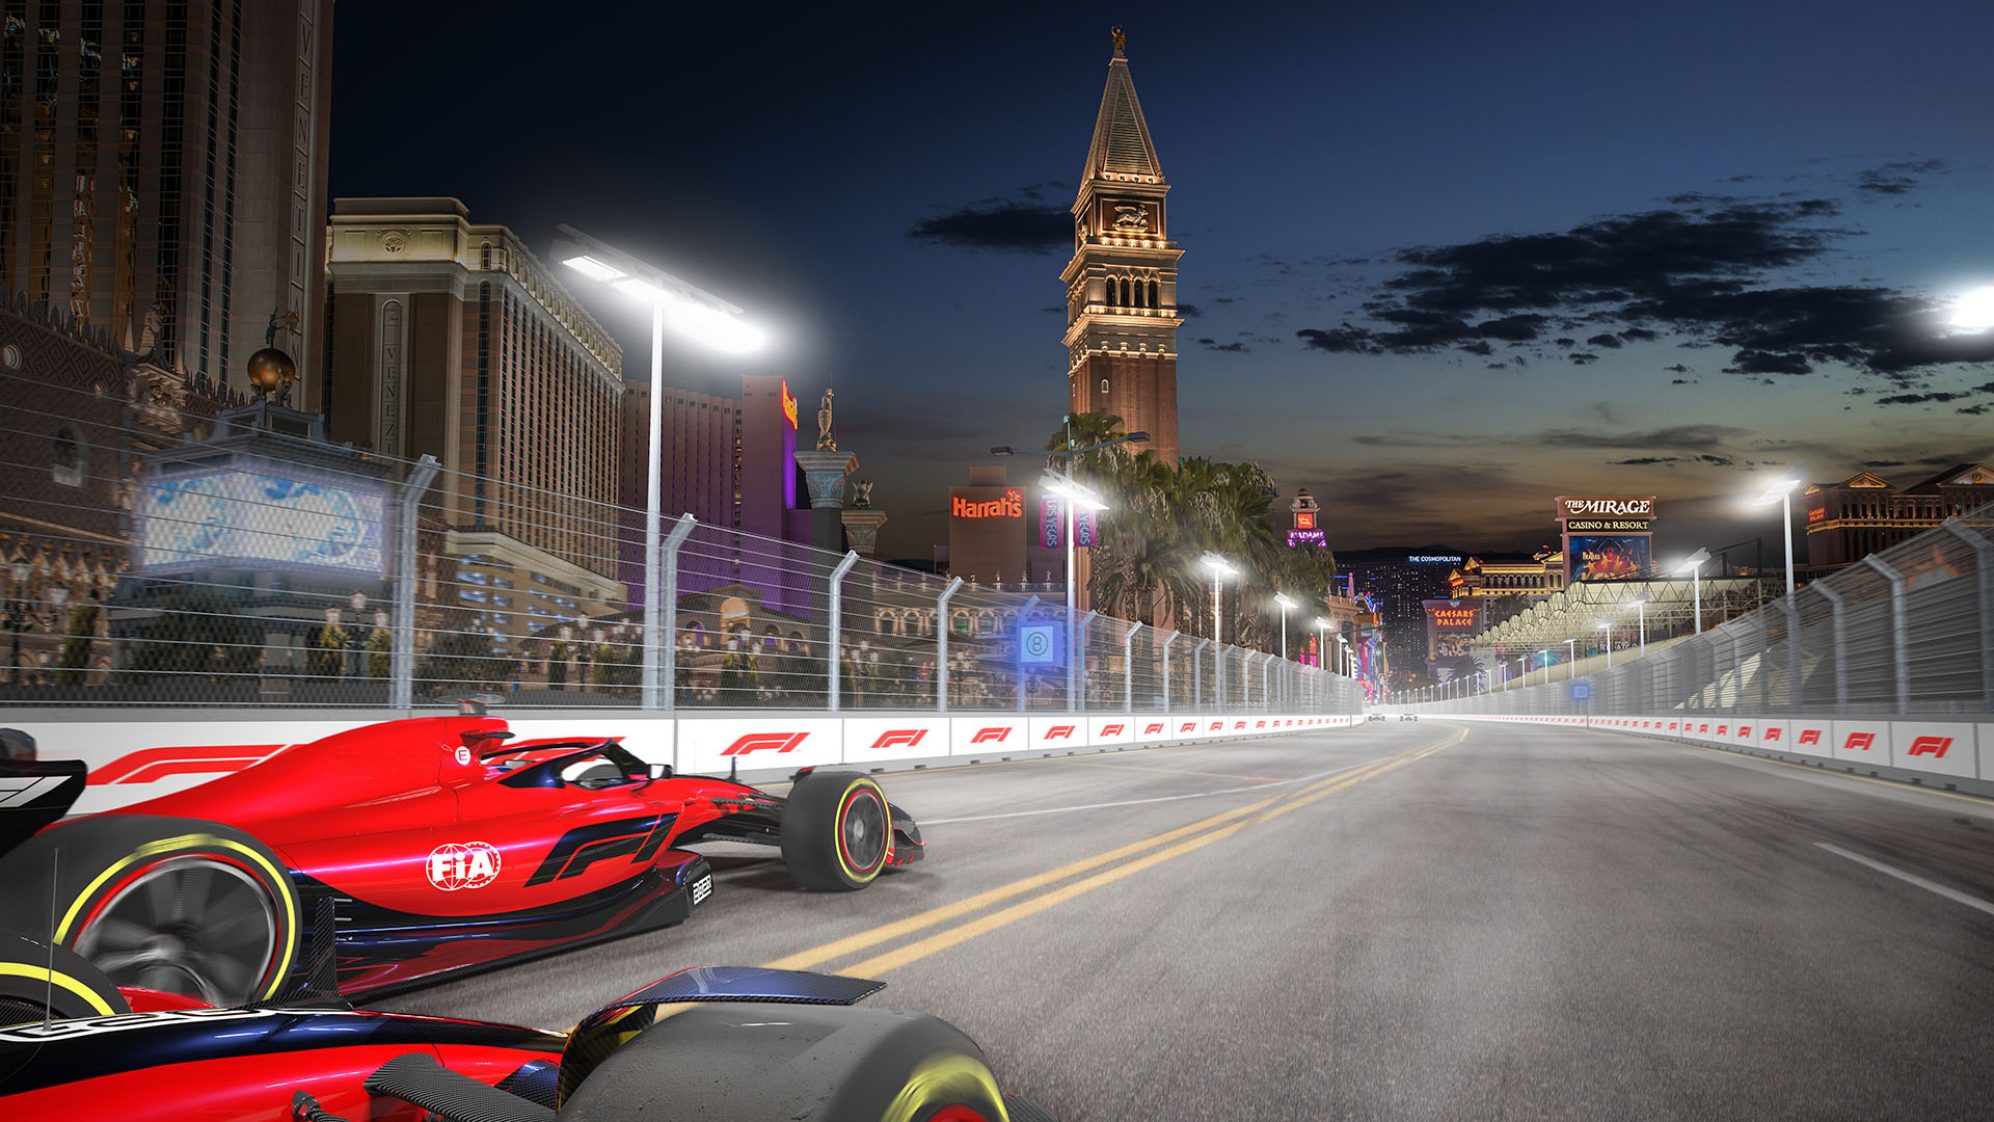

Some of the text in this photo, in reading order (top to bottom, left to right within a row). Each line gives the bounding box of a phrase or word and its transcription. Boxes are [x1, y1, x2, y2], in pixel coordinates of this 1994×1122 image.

[1565, 500, 1650, 515] THE MIRAGE
[1568, 521, 1648, 529] CASINO & RESORT
